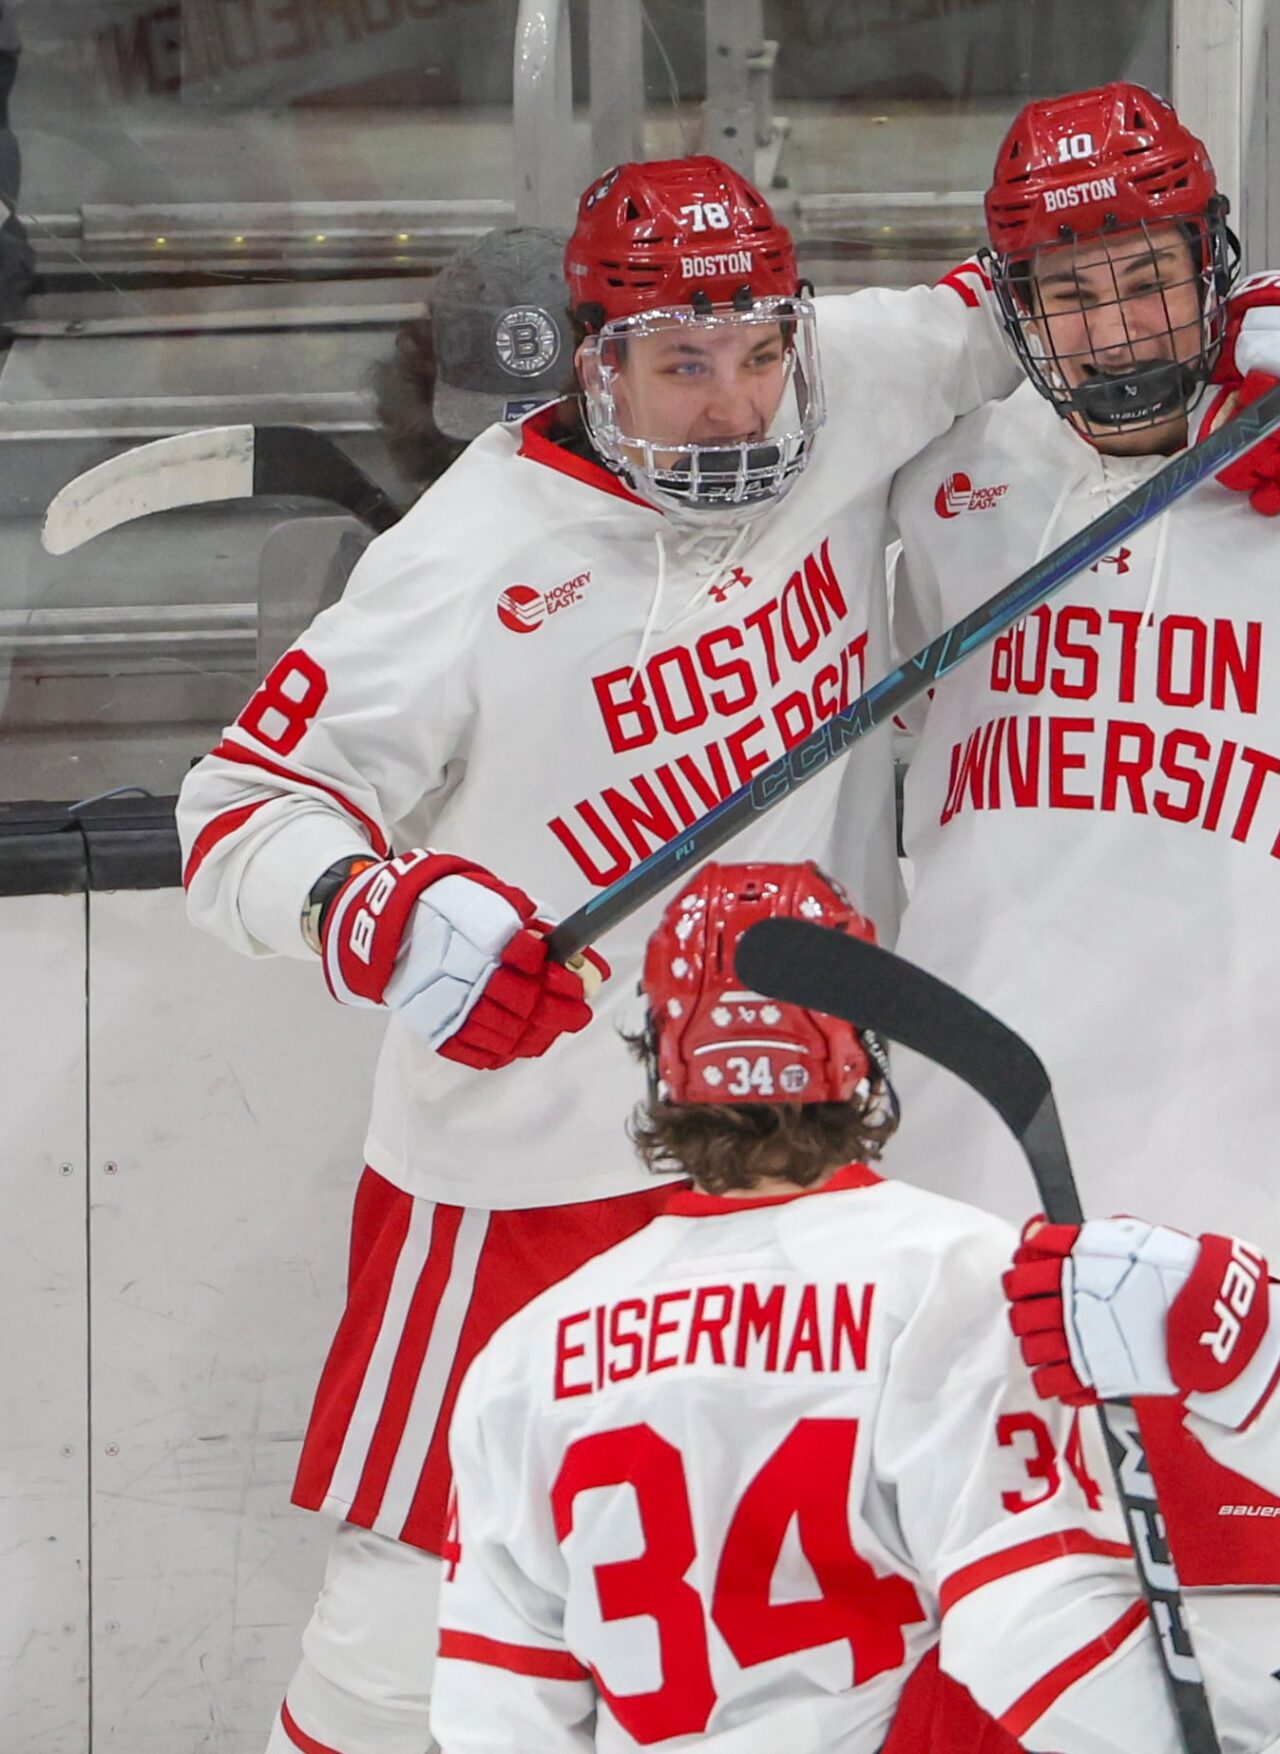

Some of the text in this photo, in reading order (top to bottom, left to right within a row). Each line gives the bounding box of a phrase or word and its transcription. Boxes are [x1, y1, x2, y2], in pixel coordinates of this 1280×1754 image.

[1057, 133, 1093, 163] 10
[1043, 177, 1118, 212] BOSTON
[680, 203, 731, 232] 78
[680, 251, 752, 278] BOSTON
[967, 498, 994, 511] EAST
[971, 484, 1009, 499] HOCKEY
[544, 571, 591, 603] HOCKEY
[546, 591, 576, 615] EAST
[593, 542, 847, 753] BOSTON
[991, 605, 1262, 715] BOSTON
[750, 694, 878, 811] CCM
[349, 847, 437, 965] BAU
[726, 1056, 774, 1095] 34
[554, 1282, 875, 1401] EISERMAN
[1100, 1403, 1203, 1683] CCM
[549, 1416, 927, 1746] 34
